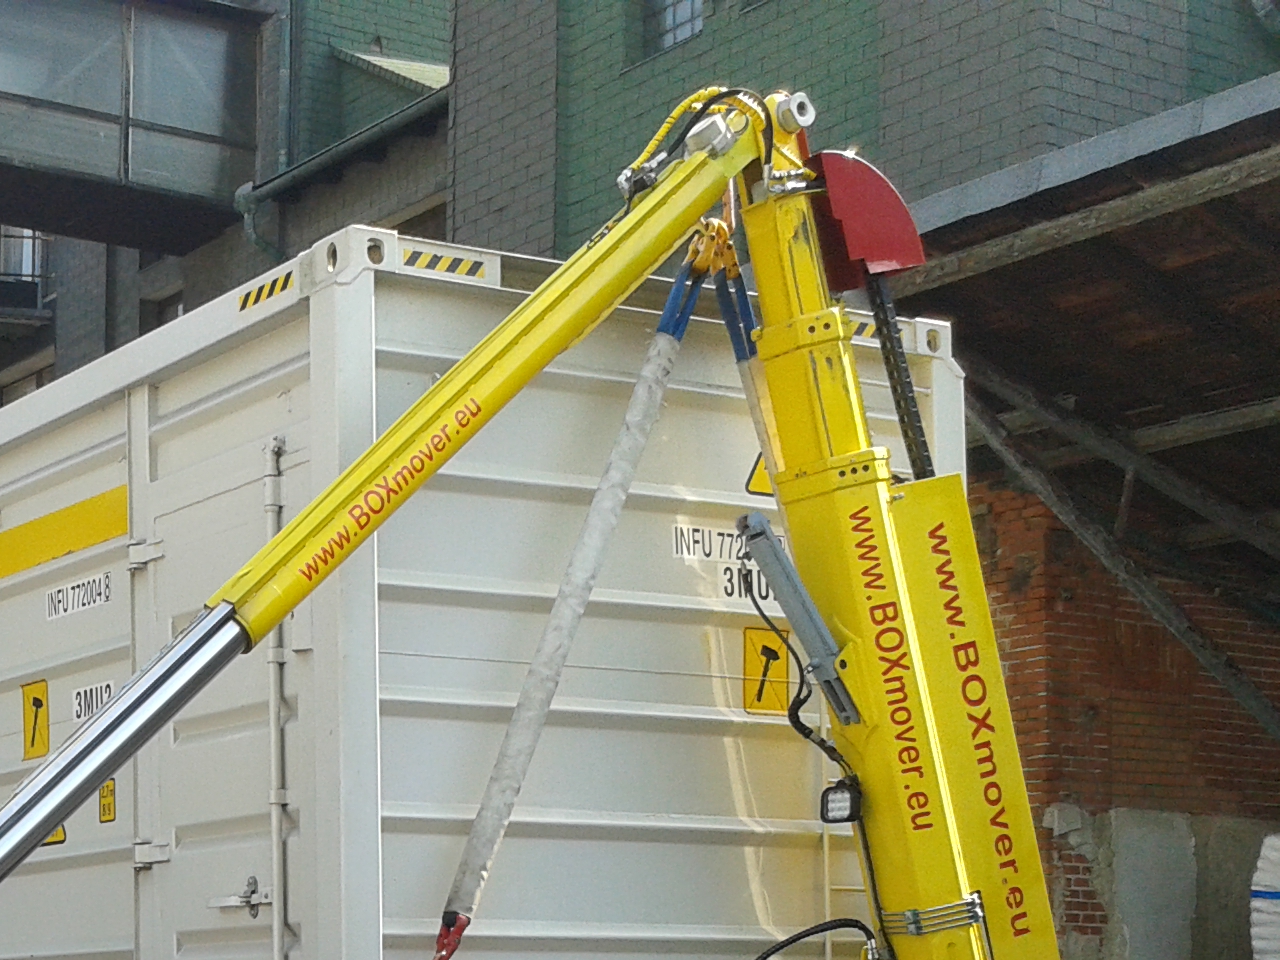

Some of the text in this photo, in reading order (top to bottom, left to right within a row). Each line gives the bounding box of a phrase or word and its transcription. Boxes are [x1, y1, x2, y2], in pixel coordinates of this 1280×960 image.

[298, 397, 482, 582] www.BOXmover.eu
[674, 526, 751, 560] INFU 772
[47, 586, 69, 618] INFU
[723, 566, 771, 601] 3MU
[848, 505, 934, 832] www.BOXmover.eu
[927, 521, 1032, 939] www.BOXmover.eu
